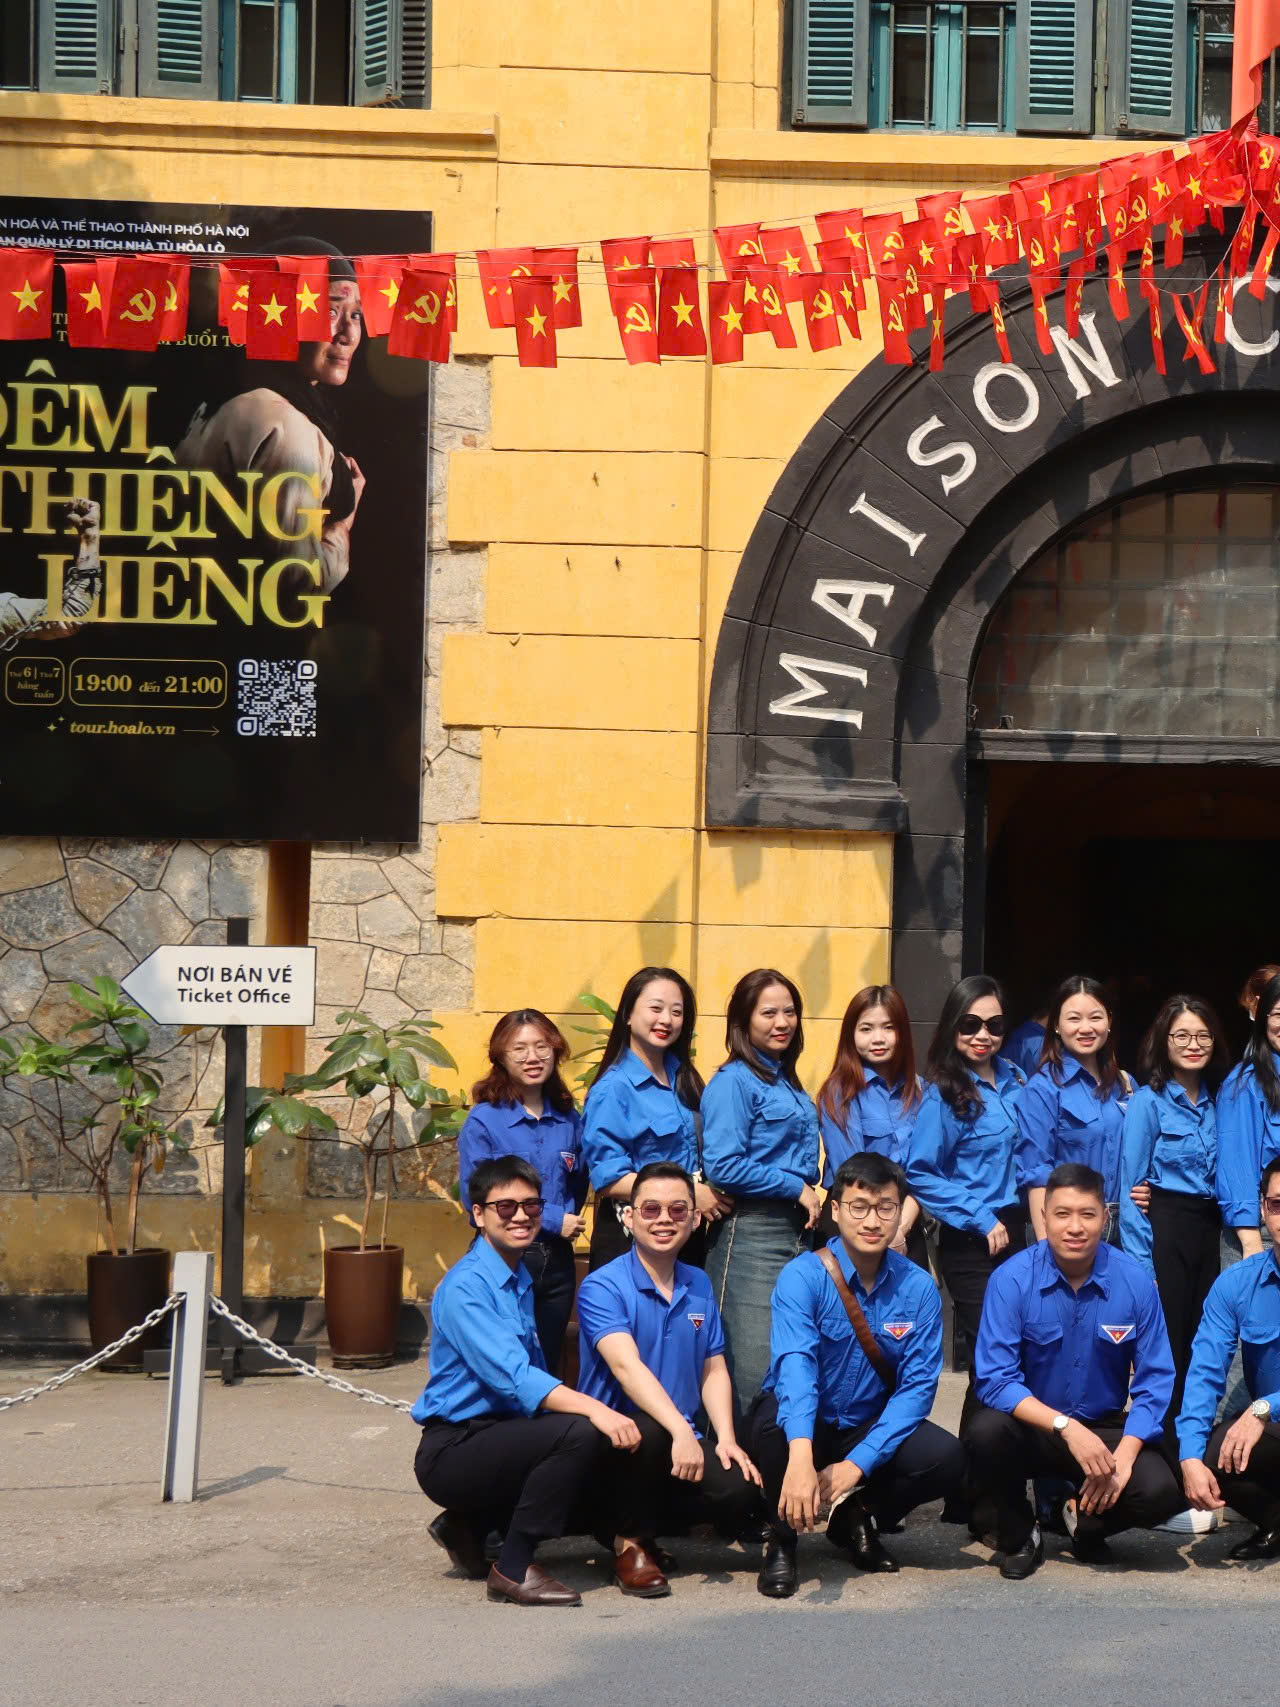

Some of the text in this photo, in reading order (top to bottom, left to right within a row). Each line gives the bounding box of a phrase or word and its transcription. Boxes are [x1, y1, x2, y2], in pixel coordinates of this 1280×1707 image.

[10, 217, 40, 230] HOÁ
[41, 218, 60, 231] VÀ
[88, 221, 125, 233] THAO
[127, 221, 172, 235] THÀNH
[174, 222, 203, 236] PHỐ
[205, 223, 224, 237] HÀ
[226, 224, 250, 239] NỘI
[77, 238, 91, 250] DI
[207, 241, 226, 253] LÒ
[0, 359, 158, 453] ÊM
[768, 309, 1122, 730] MAISON
[37, 534, 332, 629] LIÊNG
[23, 666, 32, 678] 6
[52, 667, 61, 678] 7
[74, 674, 132, 692] 19:00
[164, 676, 223, 693] 21:00
[70, 721, 176, 735] tour.hoalo.vn
[178, 964, 293, 984] NƠI BÁN VÉ
[178, 988, 291, 1003] Ticket Office
